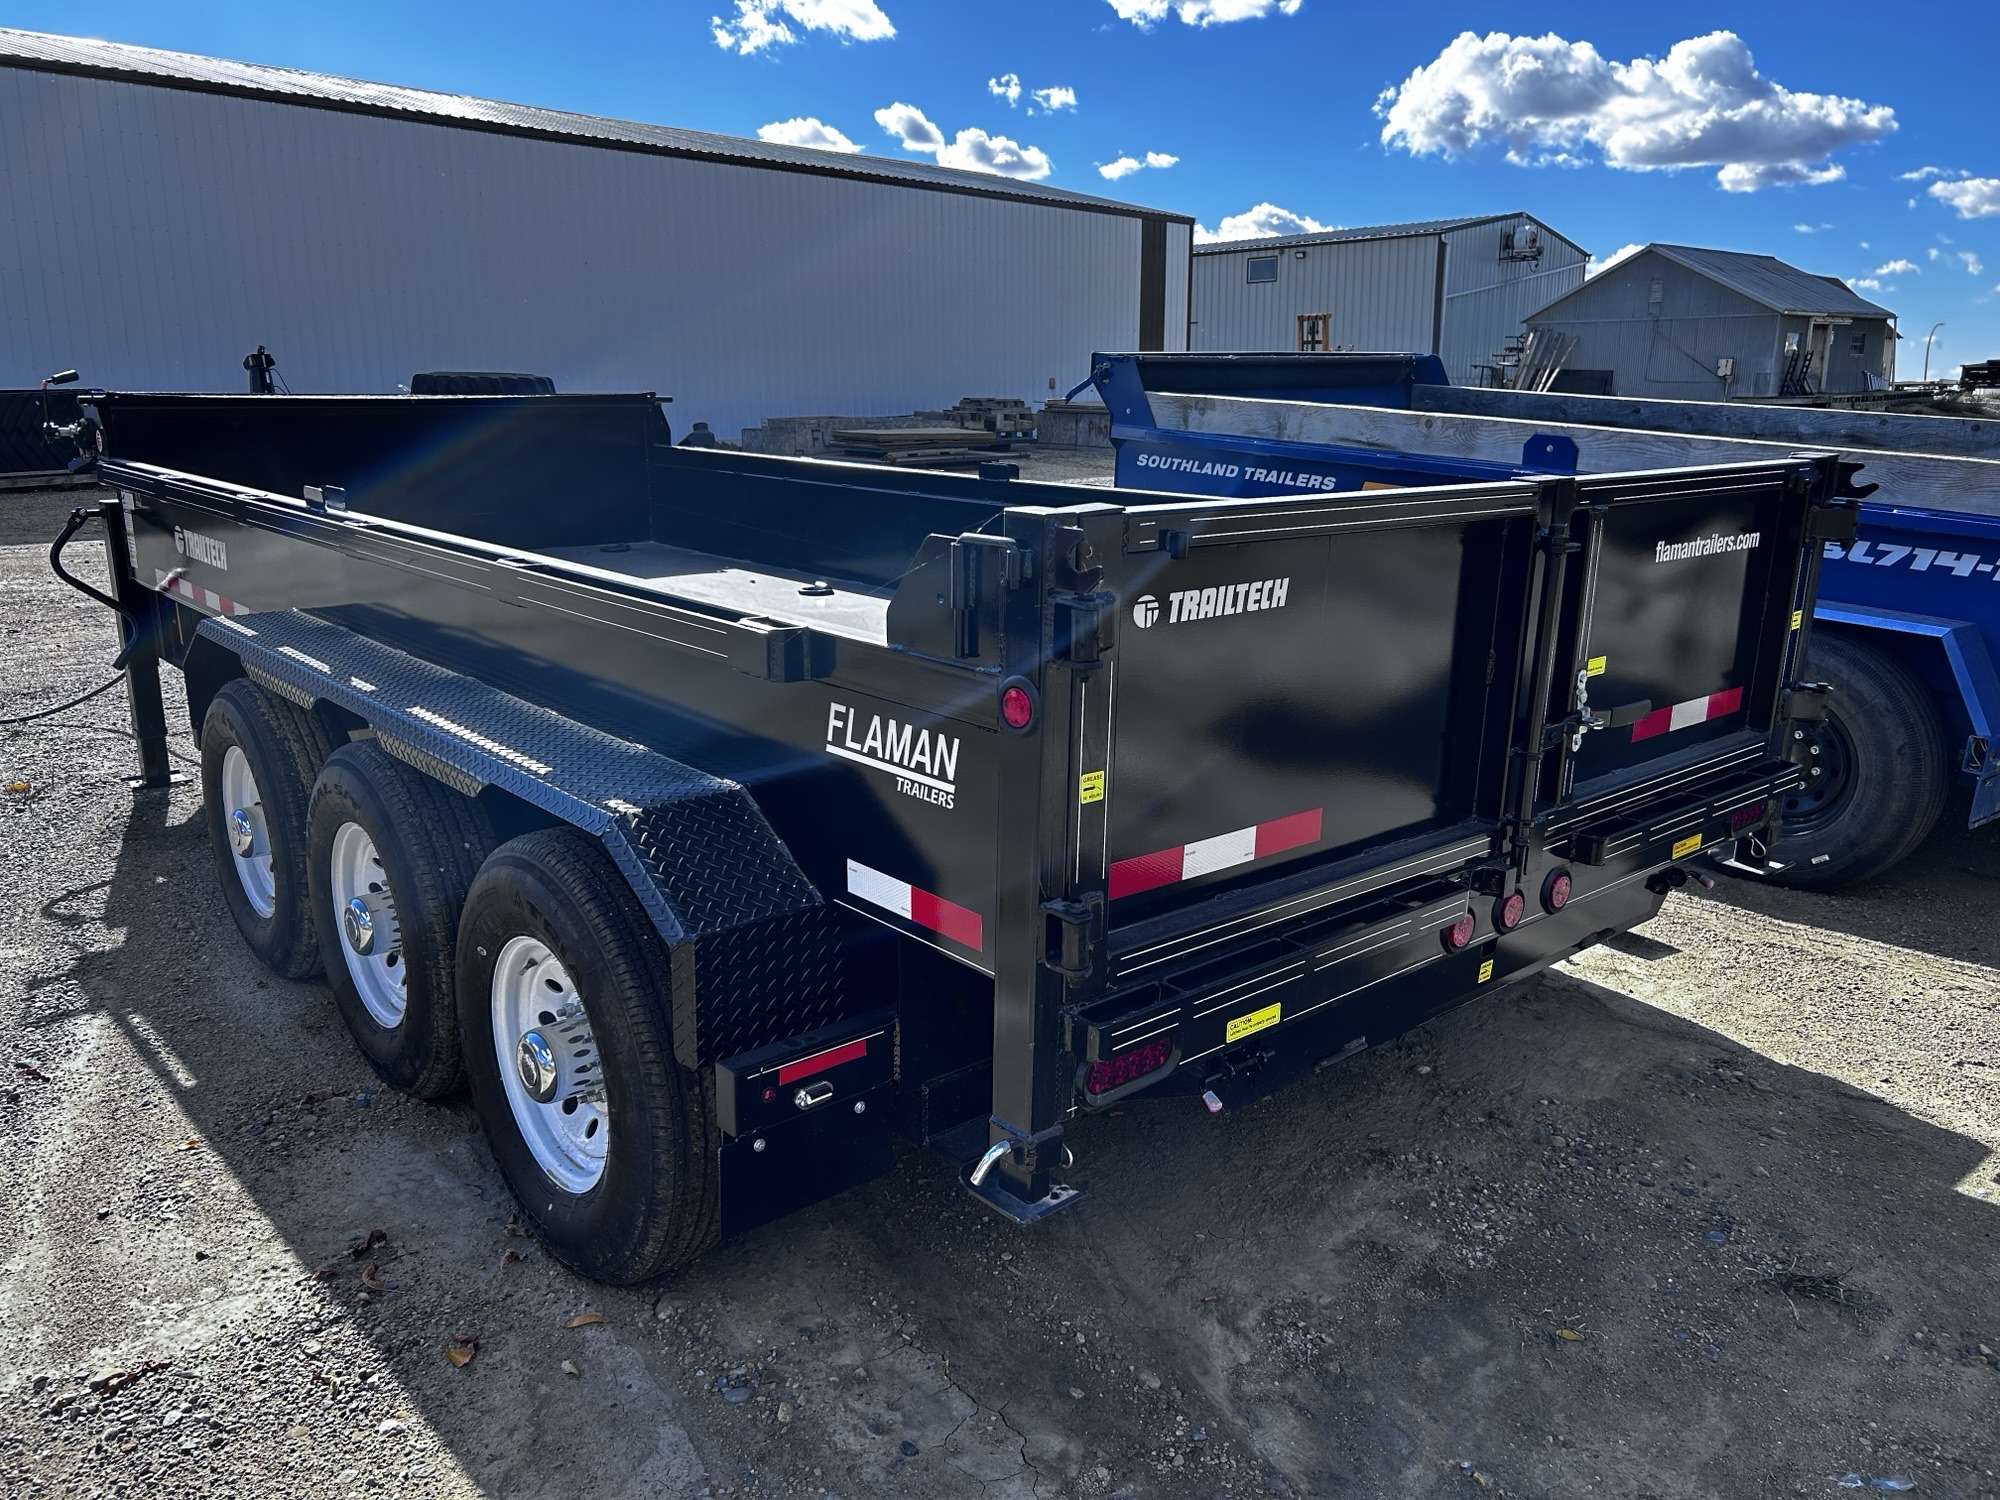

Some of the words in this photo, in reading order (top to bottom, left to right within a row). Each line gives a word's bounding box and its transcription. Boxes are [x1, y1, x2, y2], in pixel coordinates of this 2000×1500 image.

[1136, 454, 1239, 478] SOUTHLAND
[1244, 467, 1337, 491] TRAILERS
[183, 529, 228, 571] TRAILTECH
[1655, 532, 1760, 563] flamantrailers.com
[1823, 540, 2000, 581] SL714-
[1169, 577, 1290, 624] TRAILTECH
[827, 702, 960, 782] FLAMAN
[896, 776, 955, 810] TRAILERS
